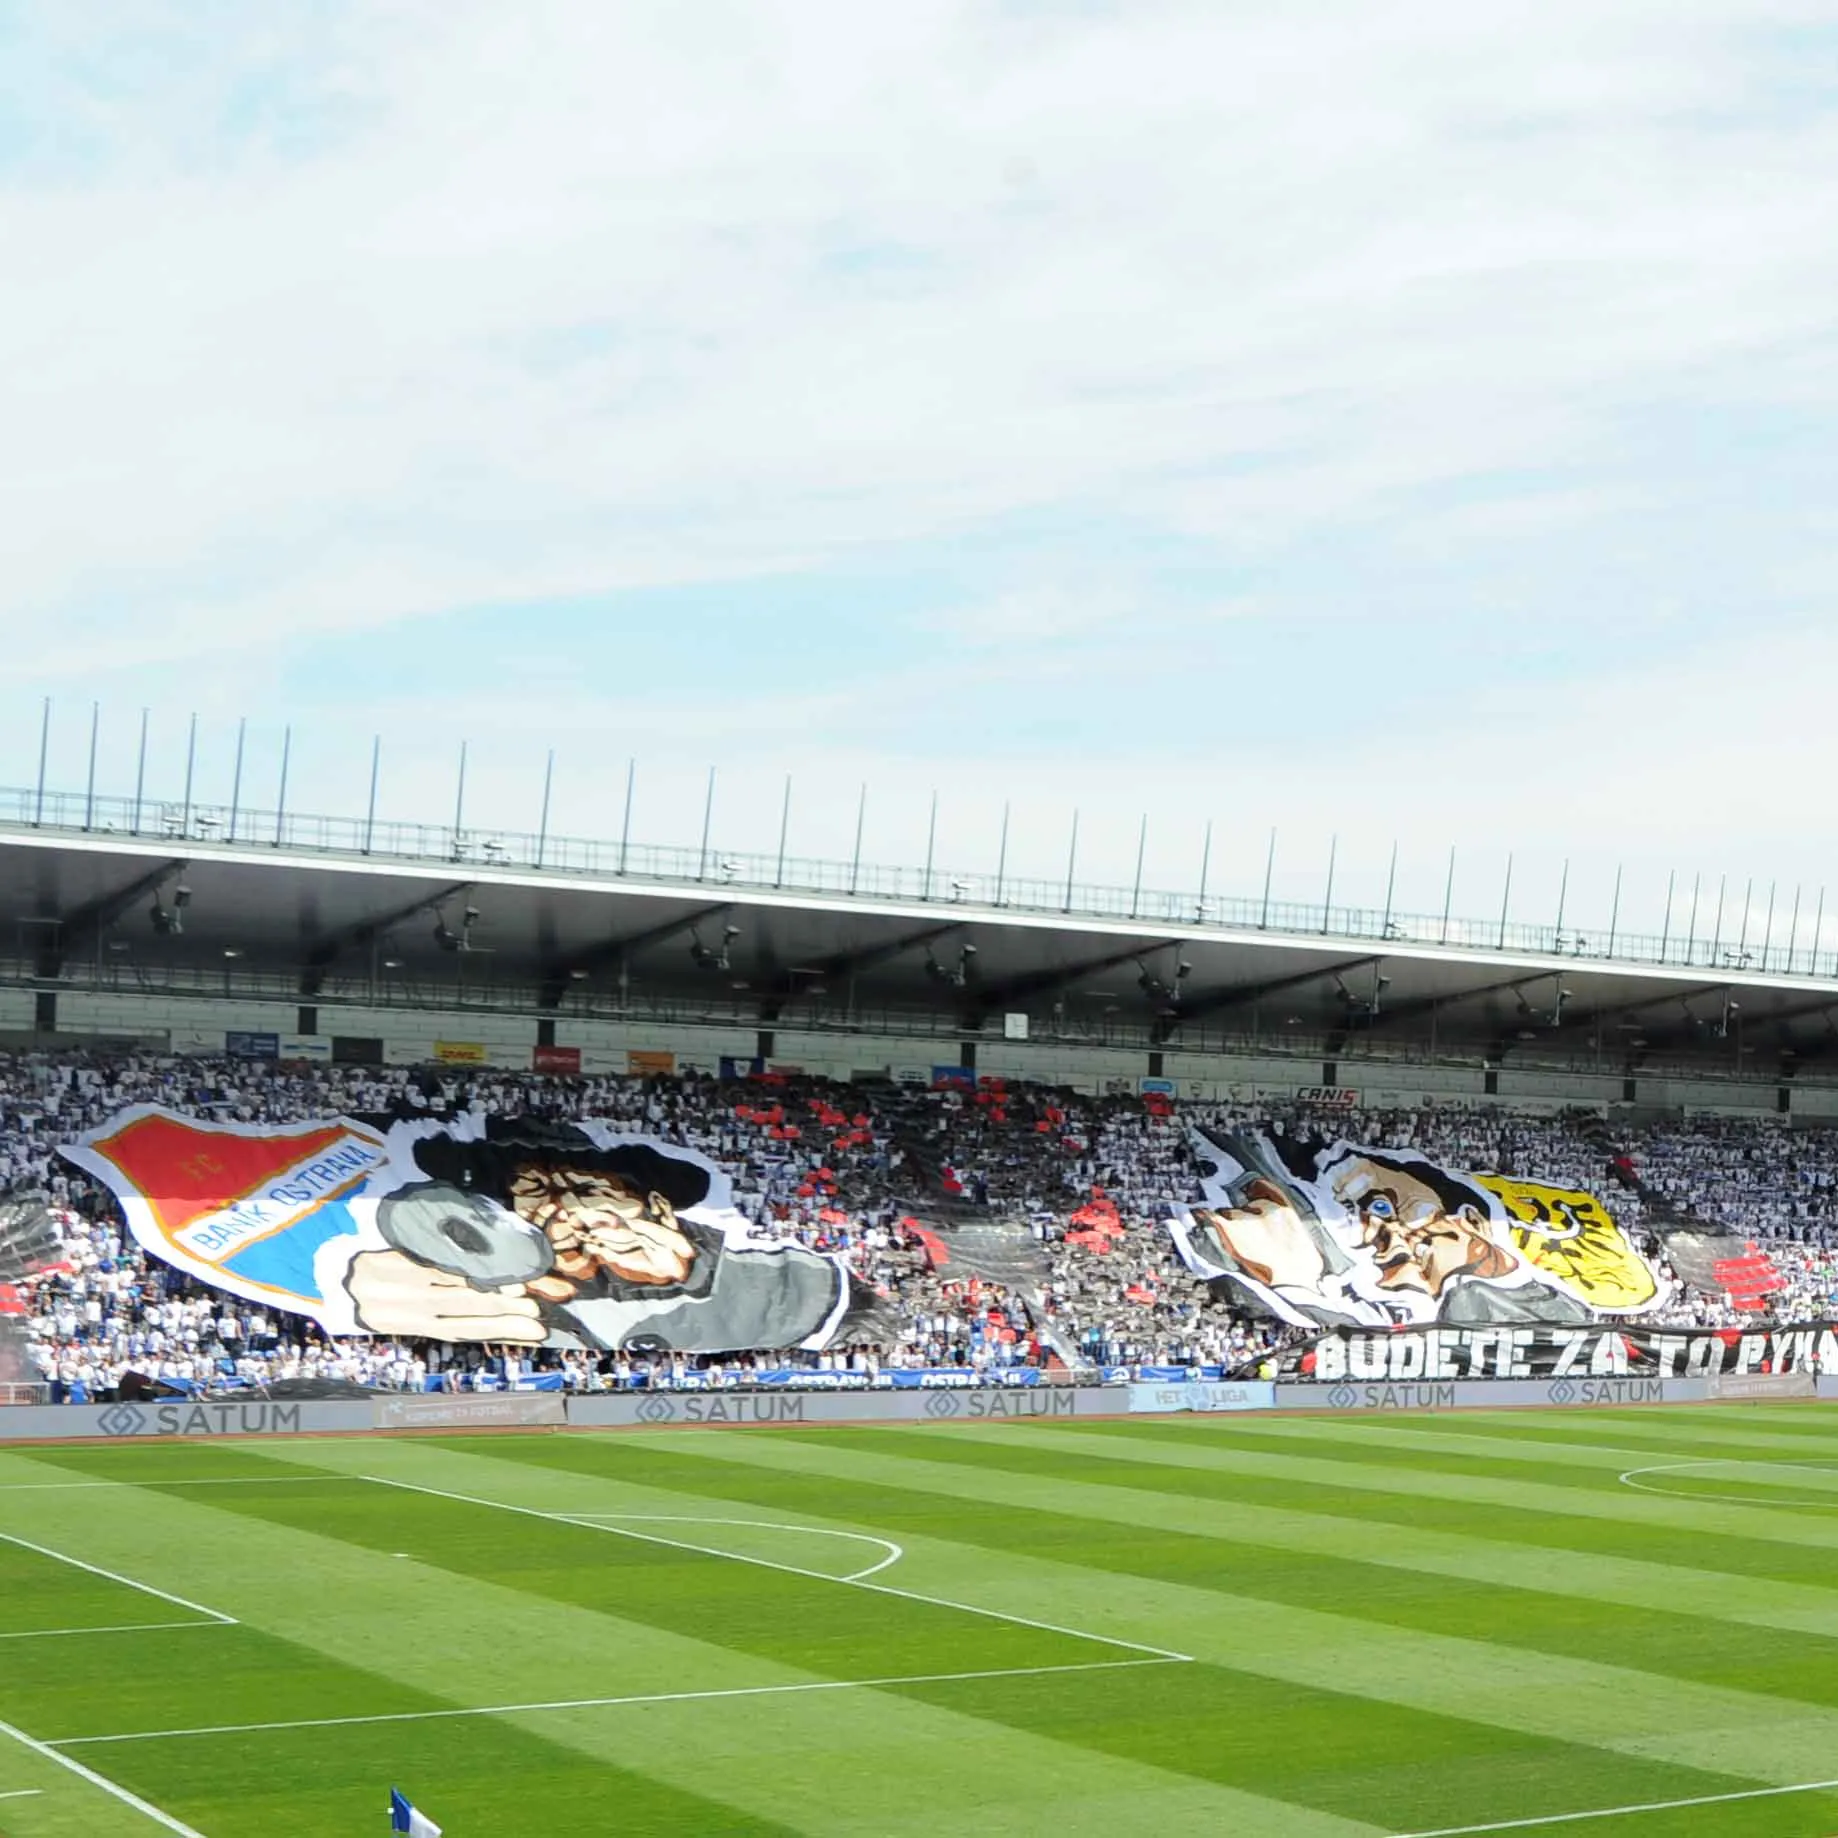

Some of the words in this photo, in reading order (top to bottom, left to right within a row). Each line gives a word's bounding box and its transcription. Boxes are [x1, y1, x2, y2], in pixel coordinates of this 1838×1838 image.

[1297, 1087, 1357, 1105] CANIS
[269, 1144, 376, 1206] OSTRAVA
[1315, 1327, 1534, 1379] BUDETE
[1552, 1330, 1628, 1377] ZA
[968, 1391, 1075, 1417] SATUM
[1365, 1384, 1455, 1408] SATUM
[1580, 1380, 1663, 1403] SATUM
[157, 1404, 300, 1434] SATUM
[685, 1396, 804, 1422] SATUM
